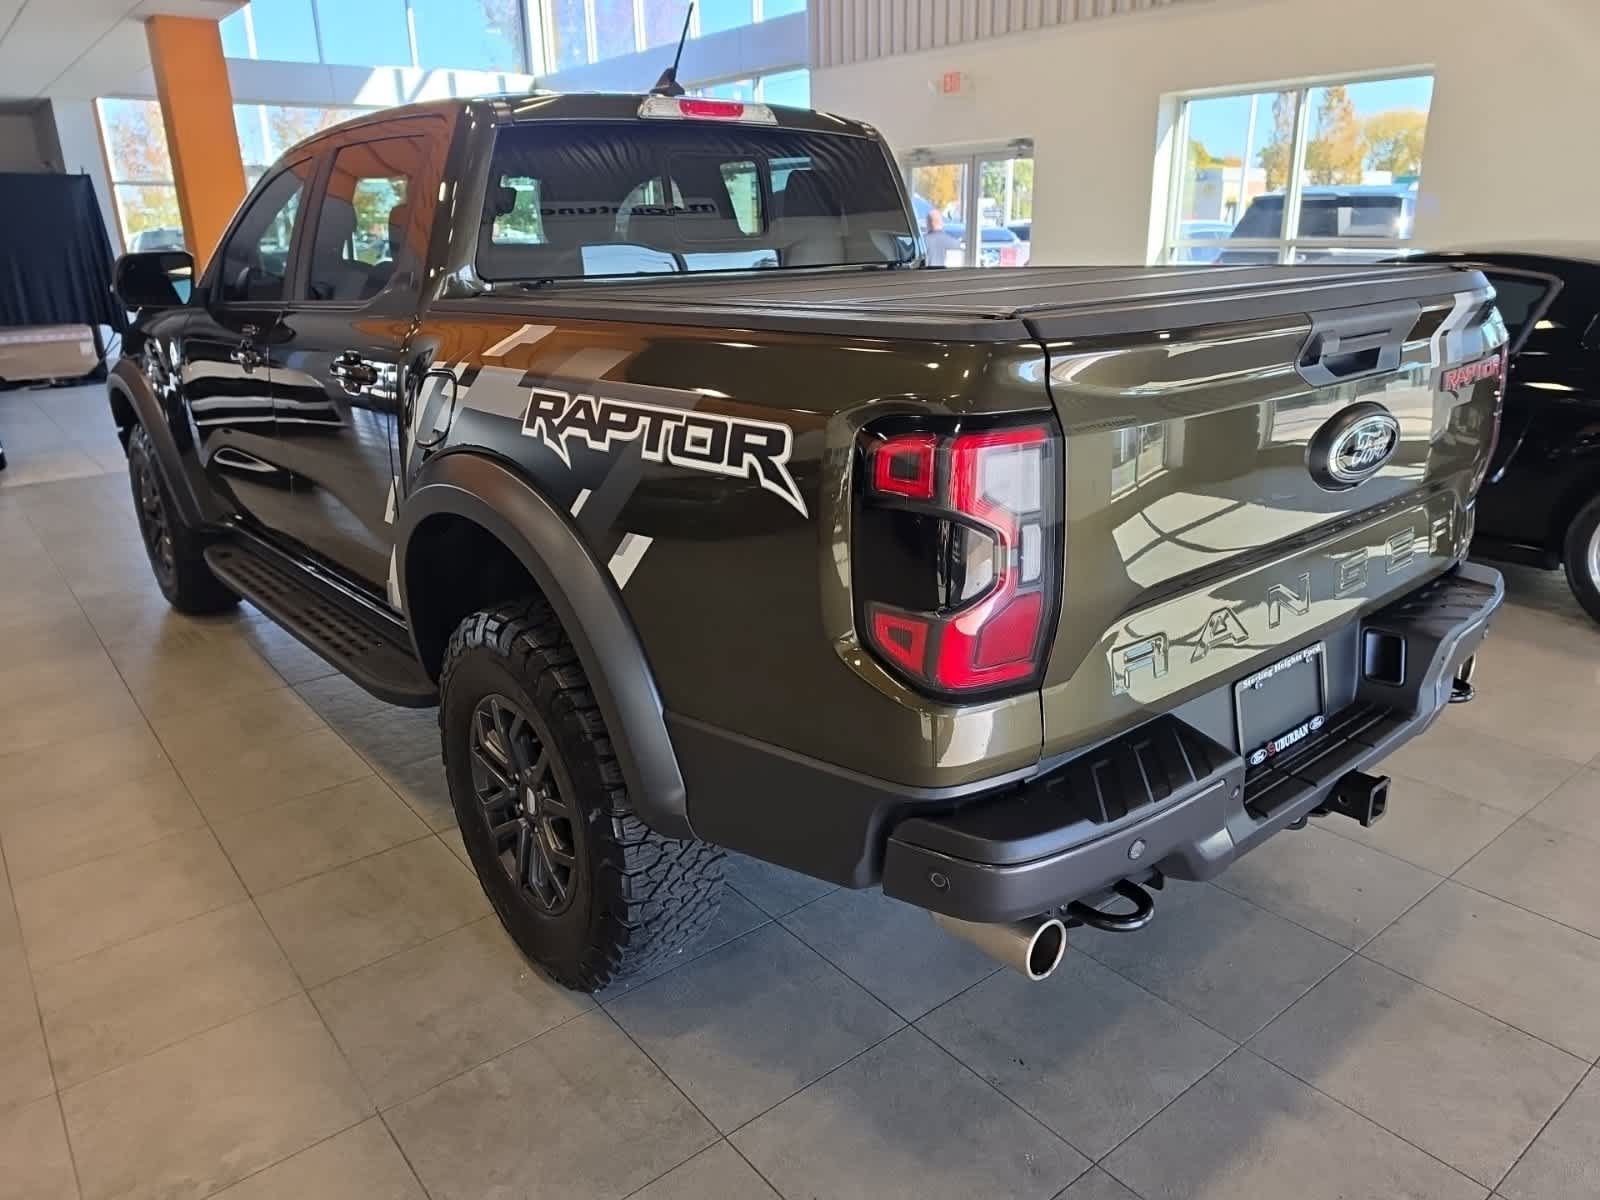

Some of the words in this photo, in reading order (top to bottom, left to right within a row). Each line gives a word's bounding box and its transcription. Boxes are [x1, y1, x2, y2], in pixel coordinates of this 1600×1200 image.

[1442, 354, 1501, 397] RAPTOR
[522, 387, 808, 519] RAPTOR
[1340, 422, 1393, 468] Ford
[1107, 509, 1454, 697] RANGER
[1243, 669, 1273, 689] Sterling
[1267, 723, 1309, 757] SUBURBAN
